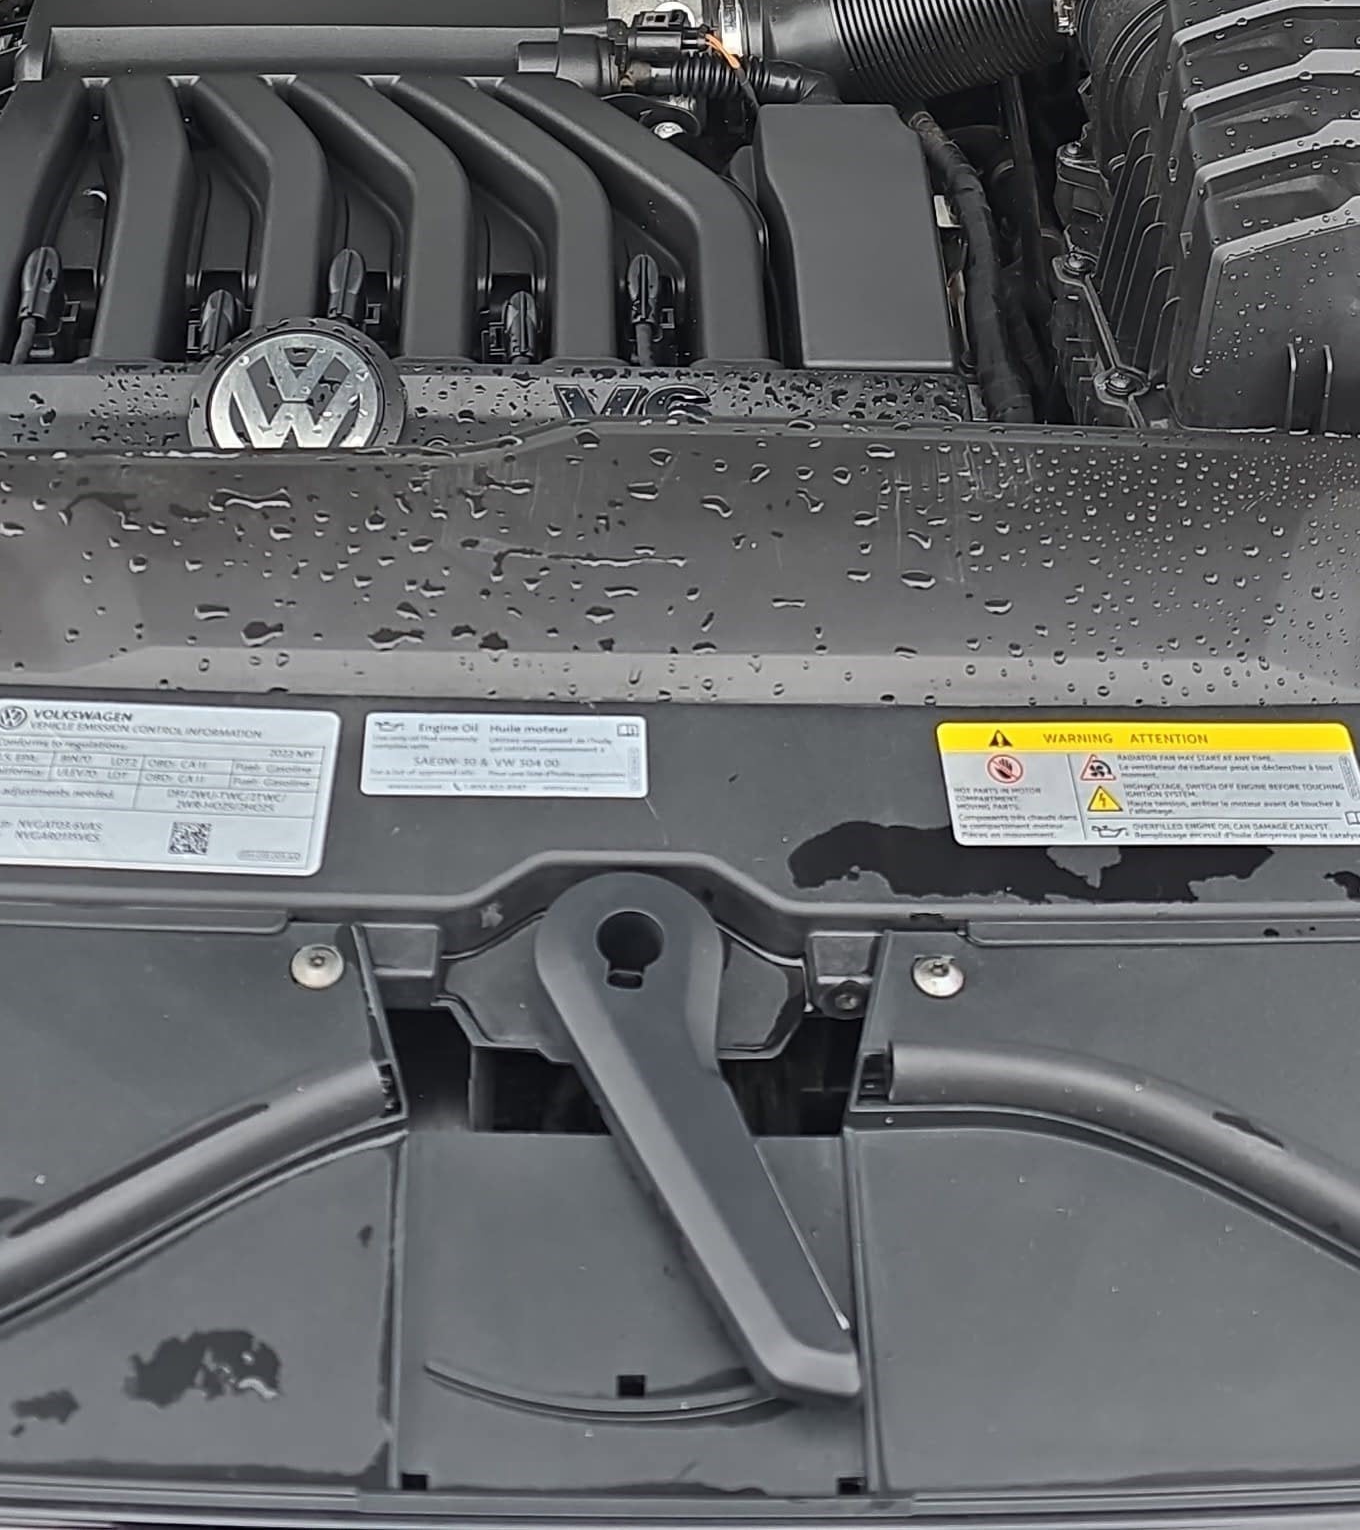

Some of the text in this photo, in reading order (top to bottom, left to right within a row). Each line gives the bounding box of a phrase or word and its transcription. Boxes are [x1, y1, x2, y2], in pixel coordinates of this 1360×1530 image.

[33, 709, 133, 722] VOLKSWAGEN
[31, 722, 263, 738] VEHICLE EMISSION CONTROL INFORMATION
[418, 723, 479, 734] Engine Oil
[489, 724, 569, 733] Huile moteur
[1042, 733, 1209, 744] WARNING ATTENTION
[51, 739, 63, 748] to
[269, 749, 293, 758] 2022
[494, 758, 516, 767] VW
[1131, 763, 1176, 771] ventilateur
[1189, 763, 1228, 771] radiateur
[1185, 783, 1217, 791] SWITCH
[1236, 783, 1267, 791] ENGINE
[1268, 783, 1301, 791] BEFORE
[956, 803, 990, 811] MOVING
[1127, 800, 1153, 808] Haute
[1301, 800, 1334, 808] toucher
[1134, 832, 1187, 840] Remplissage
